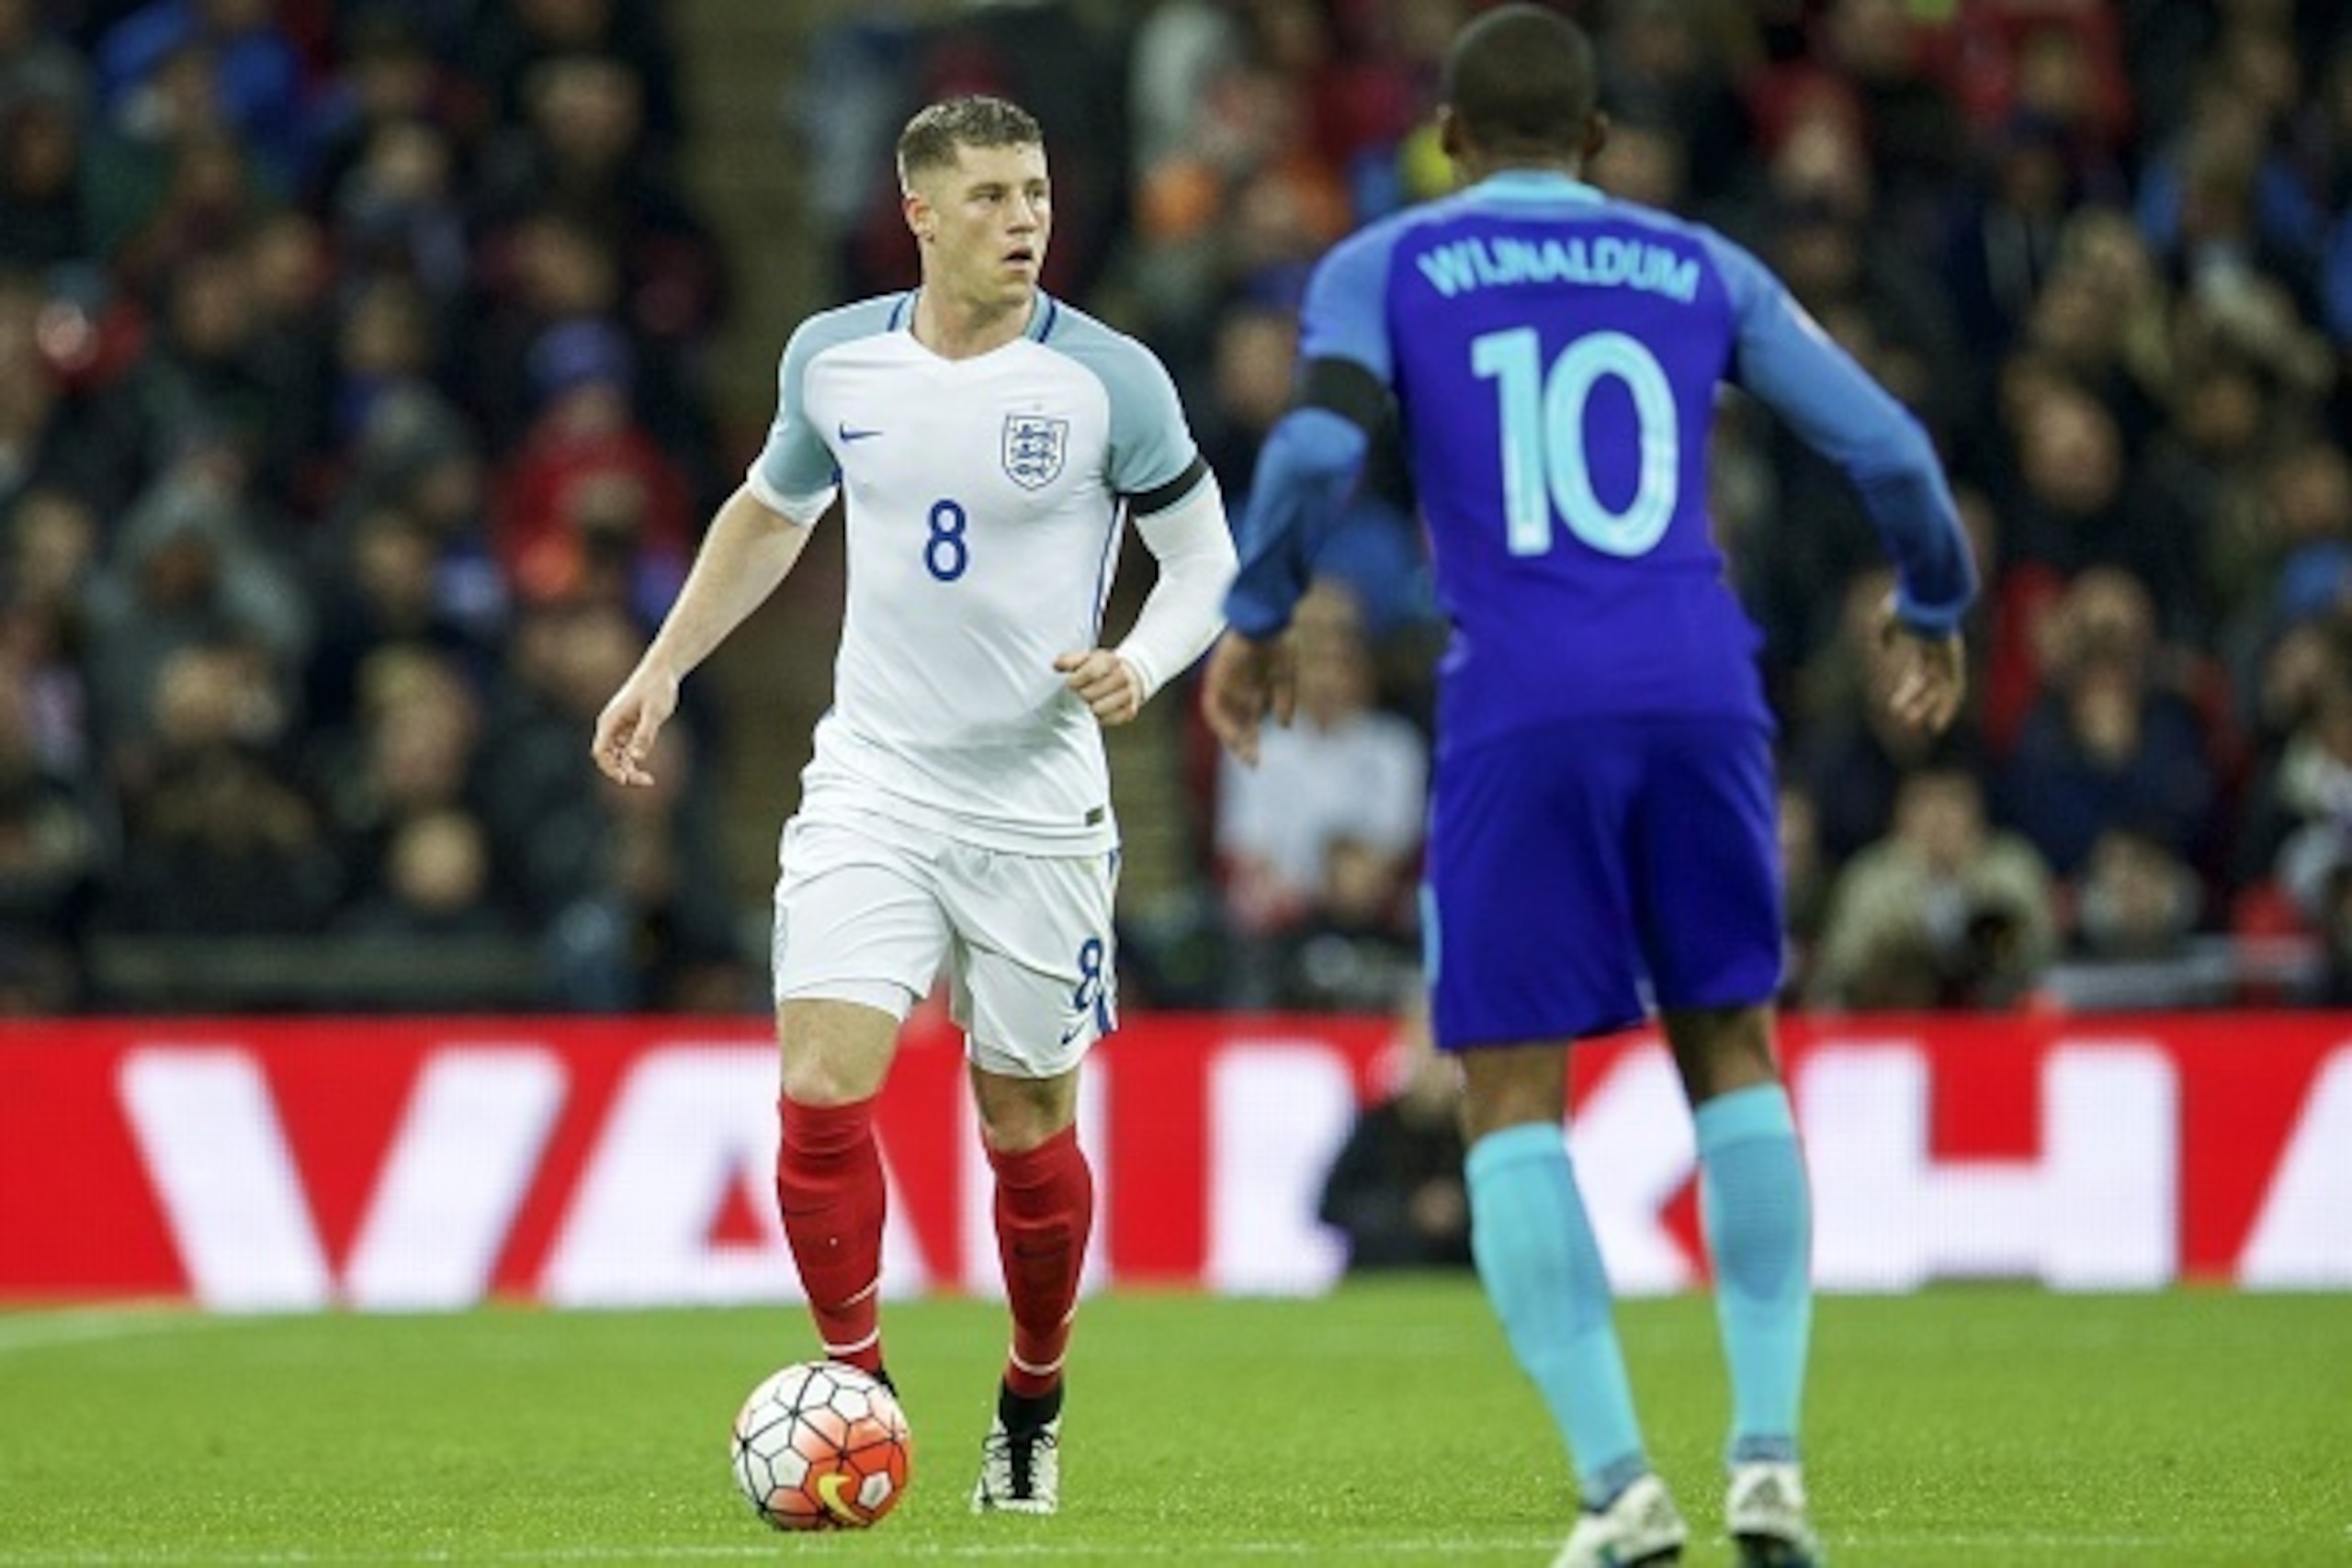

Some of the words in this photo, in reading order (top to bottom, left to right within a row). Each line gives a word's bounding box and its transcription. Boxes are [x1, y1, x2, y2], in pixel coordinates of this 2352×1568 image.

[1416, 236, 1700, 304] WIJNALDUM
[1471, 327, 1678, 557] 10
[924, 499, 968, 581] 8
